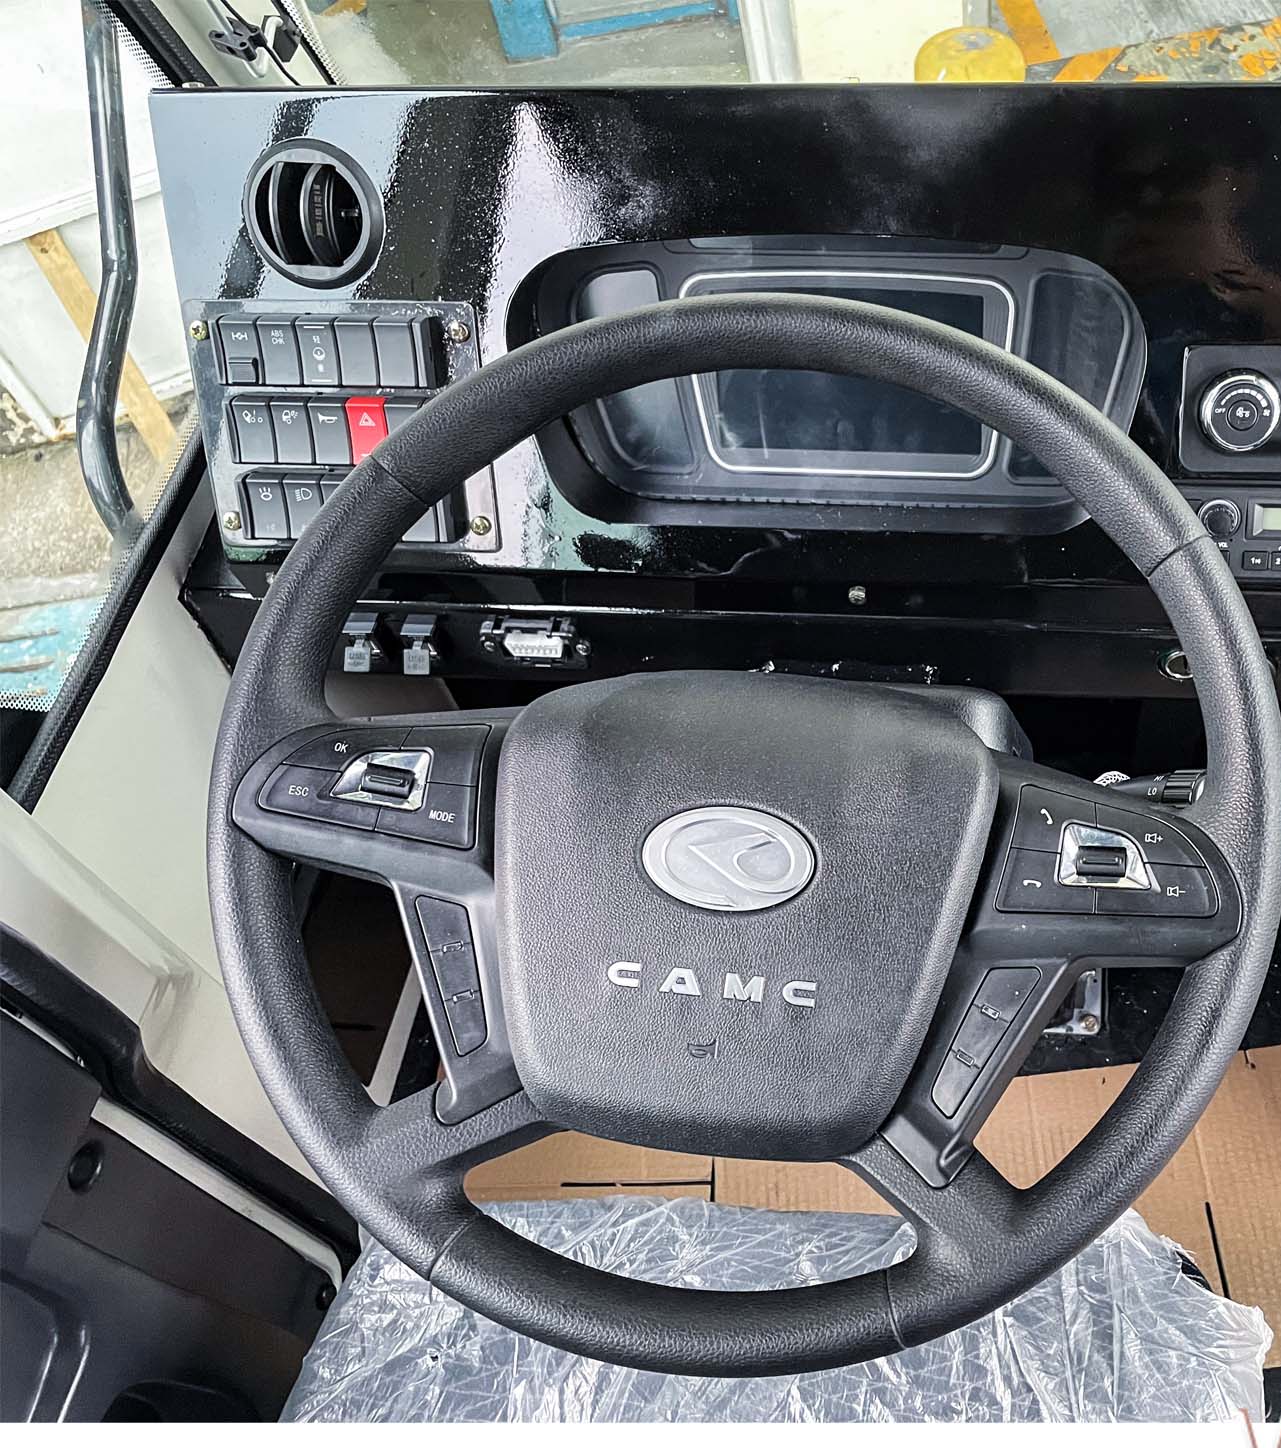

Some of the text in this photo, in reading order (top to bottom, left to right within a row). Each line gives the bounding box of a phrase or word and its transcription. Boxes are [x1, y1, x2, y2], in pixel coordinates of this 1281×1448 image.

[271, 329, 284, 338] ABS
[334, 742, 348, 753] OK
[288, 784, 309, 797] ESC
[1147, 787, 1157, 796] LO
[428, 810, 455, 823] MODE
[607, 960, 817, 1009] CAMC
